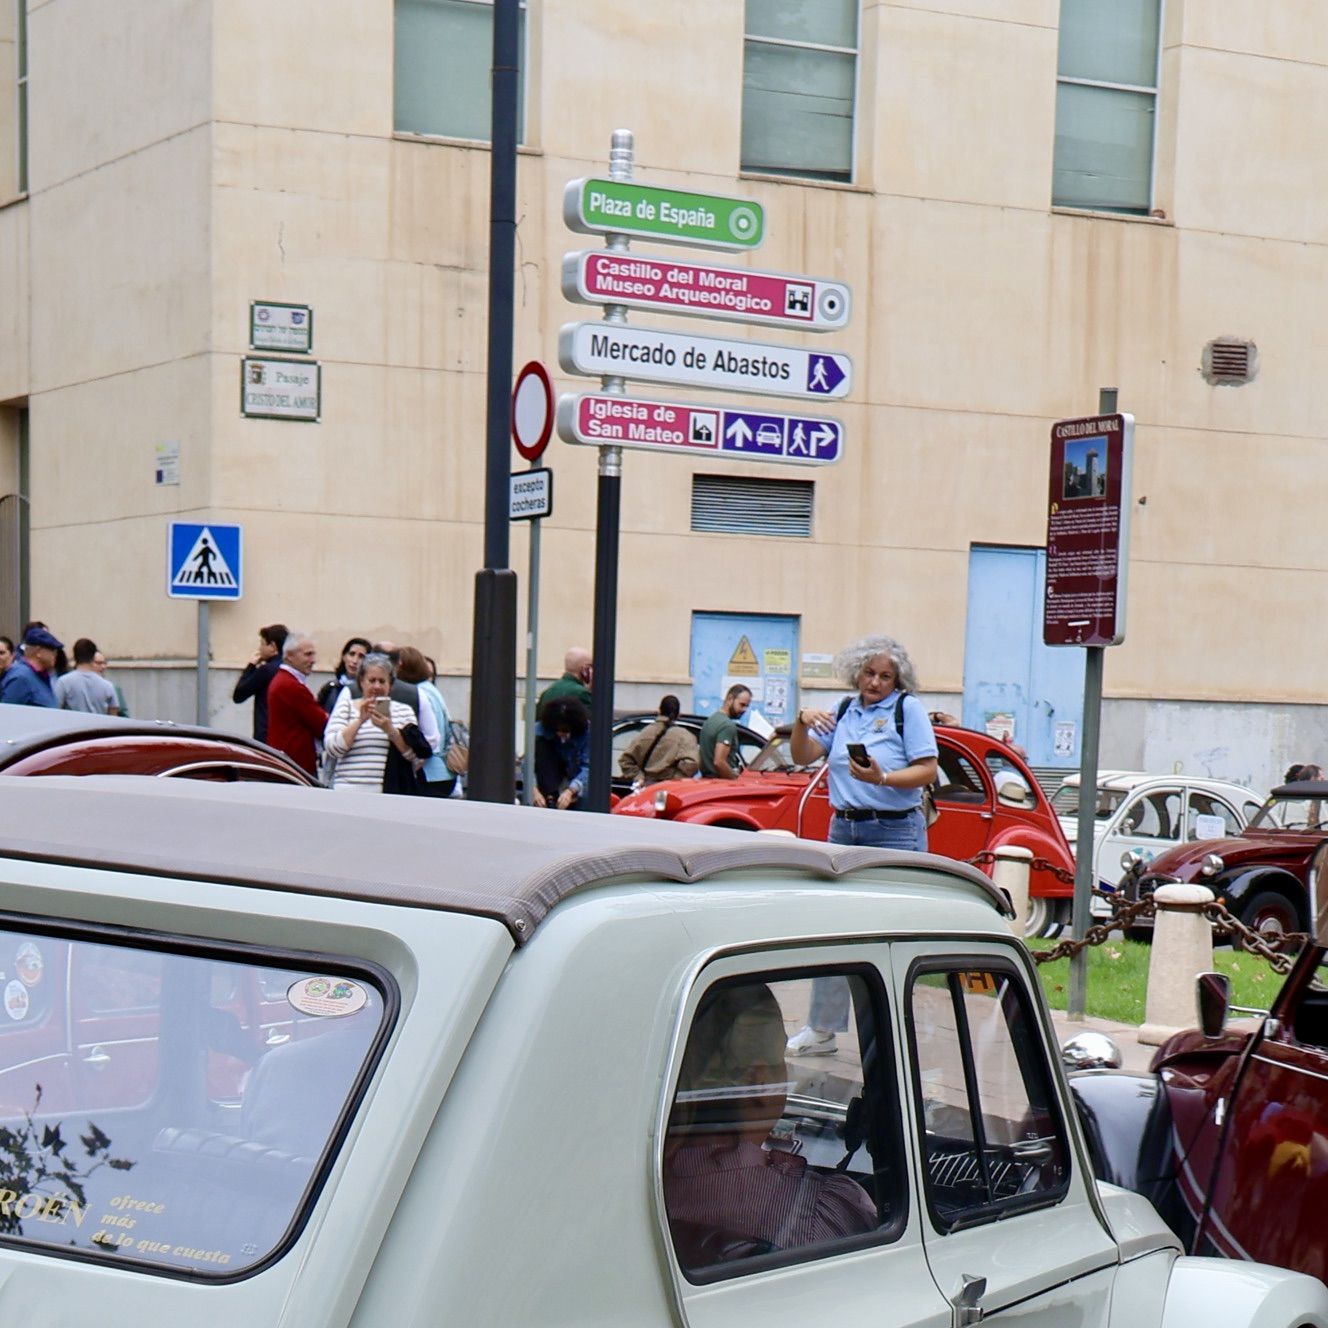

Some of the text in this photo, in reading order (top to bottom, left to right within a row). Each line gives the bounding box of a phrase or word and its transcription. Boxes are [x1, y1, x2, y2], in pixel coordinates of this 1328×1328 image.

[590, 192, 715, 228] Plaza de España
[596, 258, 747, 291] Castillo del Moral
[595, 275, 772, 311] Museo Arqueológico
[591, 334, 790, 380] Mercado de Abastos
[276, 372, 309, 386] Pasaje
[589, 398, 676, 422] Iglesia de
[588, 419, 684, 443] San Mateo
[514, 479, 544, 494] excepto
[512, 497, 546, 512] cocheras
[110, 1195, 167, 1215] ofrece
[100, 1213, 137, 1229] más
[90, 1229, 114, 1244] de
[115, 1232, 135, 1247] lo
[137, 1239, 172, 1254] que
[173, 1245, 232, 1265] cuesta
